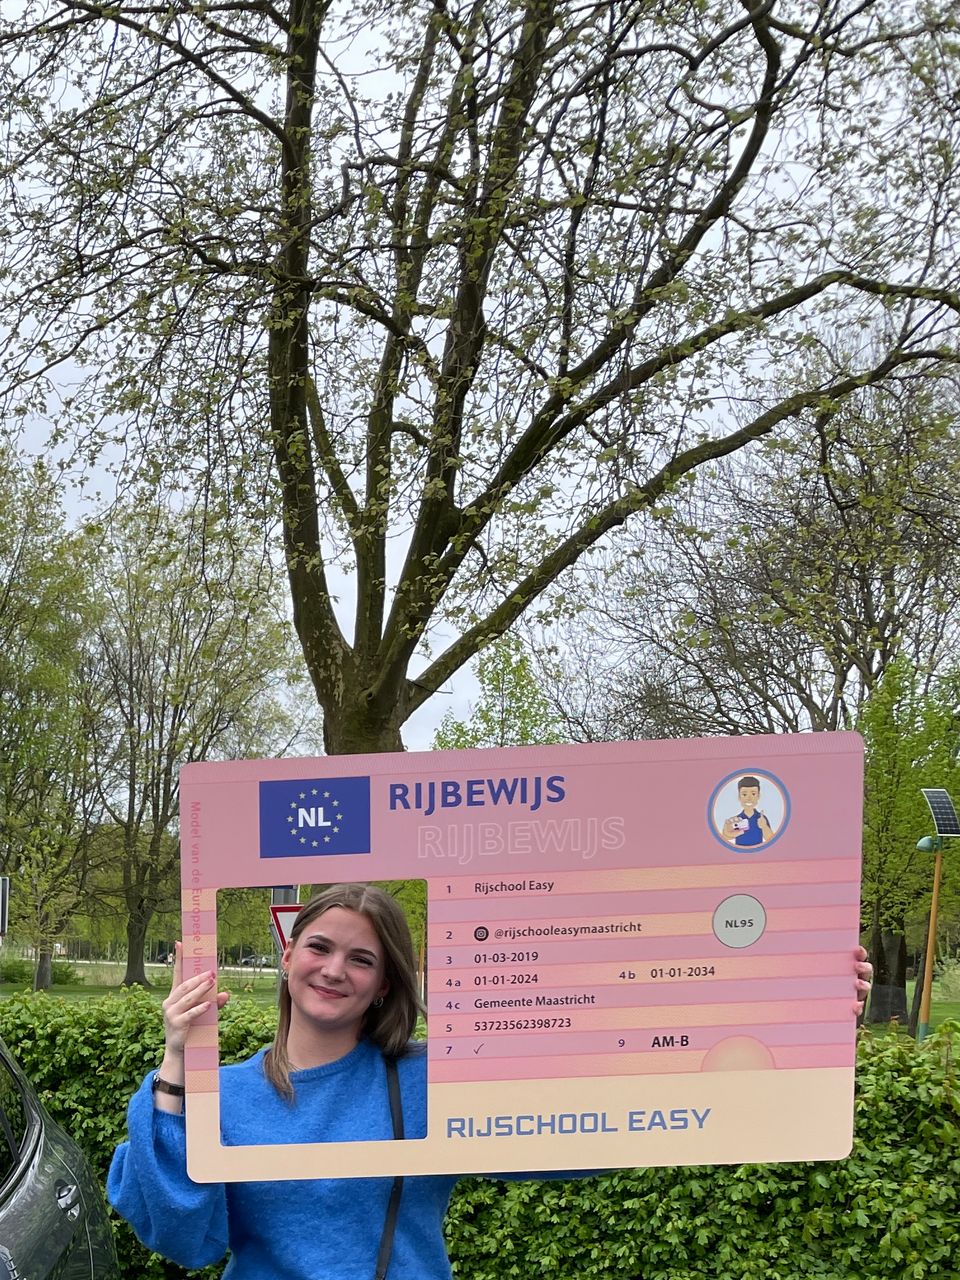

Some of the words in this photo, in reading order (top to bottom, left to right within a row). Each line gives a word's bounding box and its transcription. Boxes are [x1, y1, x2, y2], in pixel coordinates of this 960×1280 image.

[389, 775, 566, 816] RIJBEWIJS
[191, 801, 202, 838] Model
[297, 807, 332, 828] NL
[417, 816, 626, 864] RIJBEWIJS
[191, 843, 200, 864] van
[192, 869, 203, 884] de
[446, 884, 452, 894] 1
[474, 880, 527, 896] Rijschool
[528, 880, 555, 893] Easy
[190, 888, 202, 942] Europese
[445, 930, 453, 940] 2
[494, 921, 642, 940] @rijschooleasymaastricht
[724, 918, 755, 929] NL95
[445, 955, 453, 965] 3
[474, 951, 539, 964] 01-03-2019
[474, 973, 539, 986] 01-01-2024
[650, 966, 716, 979] 01-01-2034
[473, 996, 533, 1010] Gemeente
[535, 993, 596, 1006] Maastricht
[445, 1023, 453, 1033] 5
[473, 1017, 572, 1032] 53723562398723
[617, 1038, 626, 1048] 9
[651, 1034, 690, 1049] AM-B
[445, 1045, 453, 1055] 7
[446, 1112, 619, 1139] RIJSCHOOL
[628, 1107, 713, 1132] EASY
